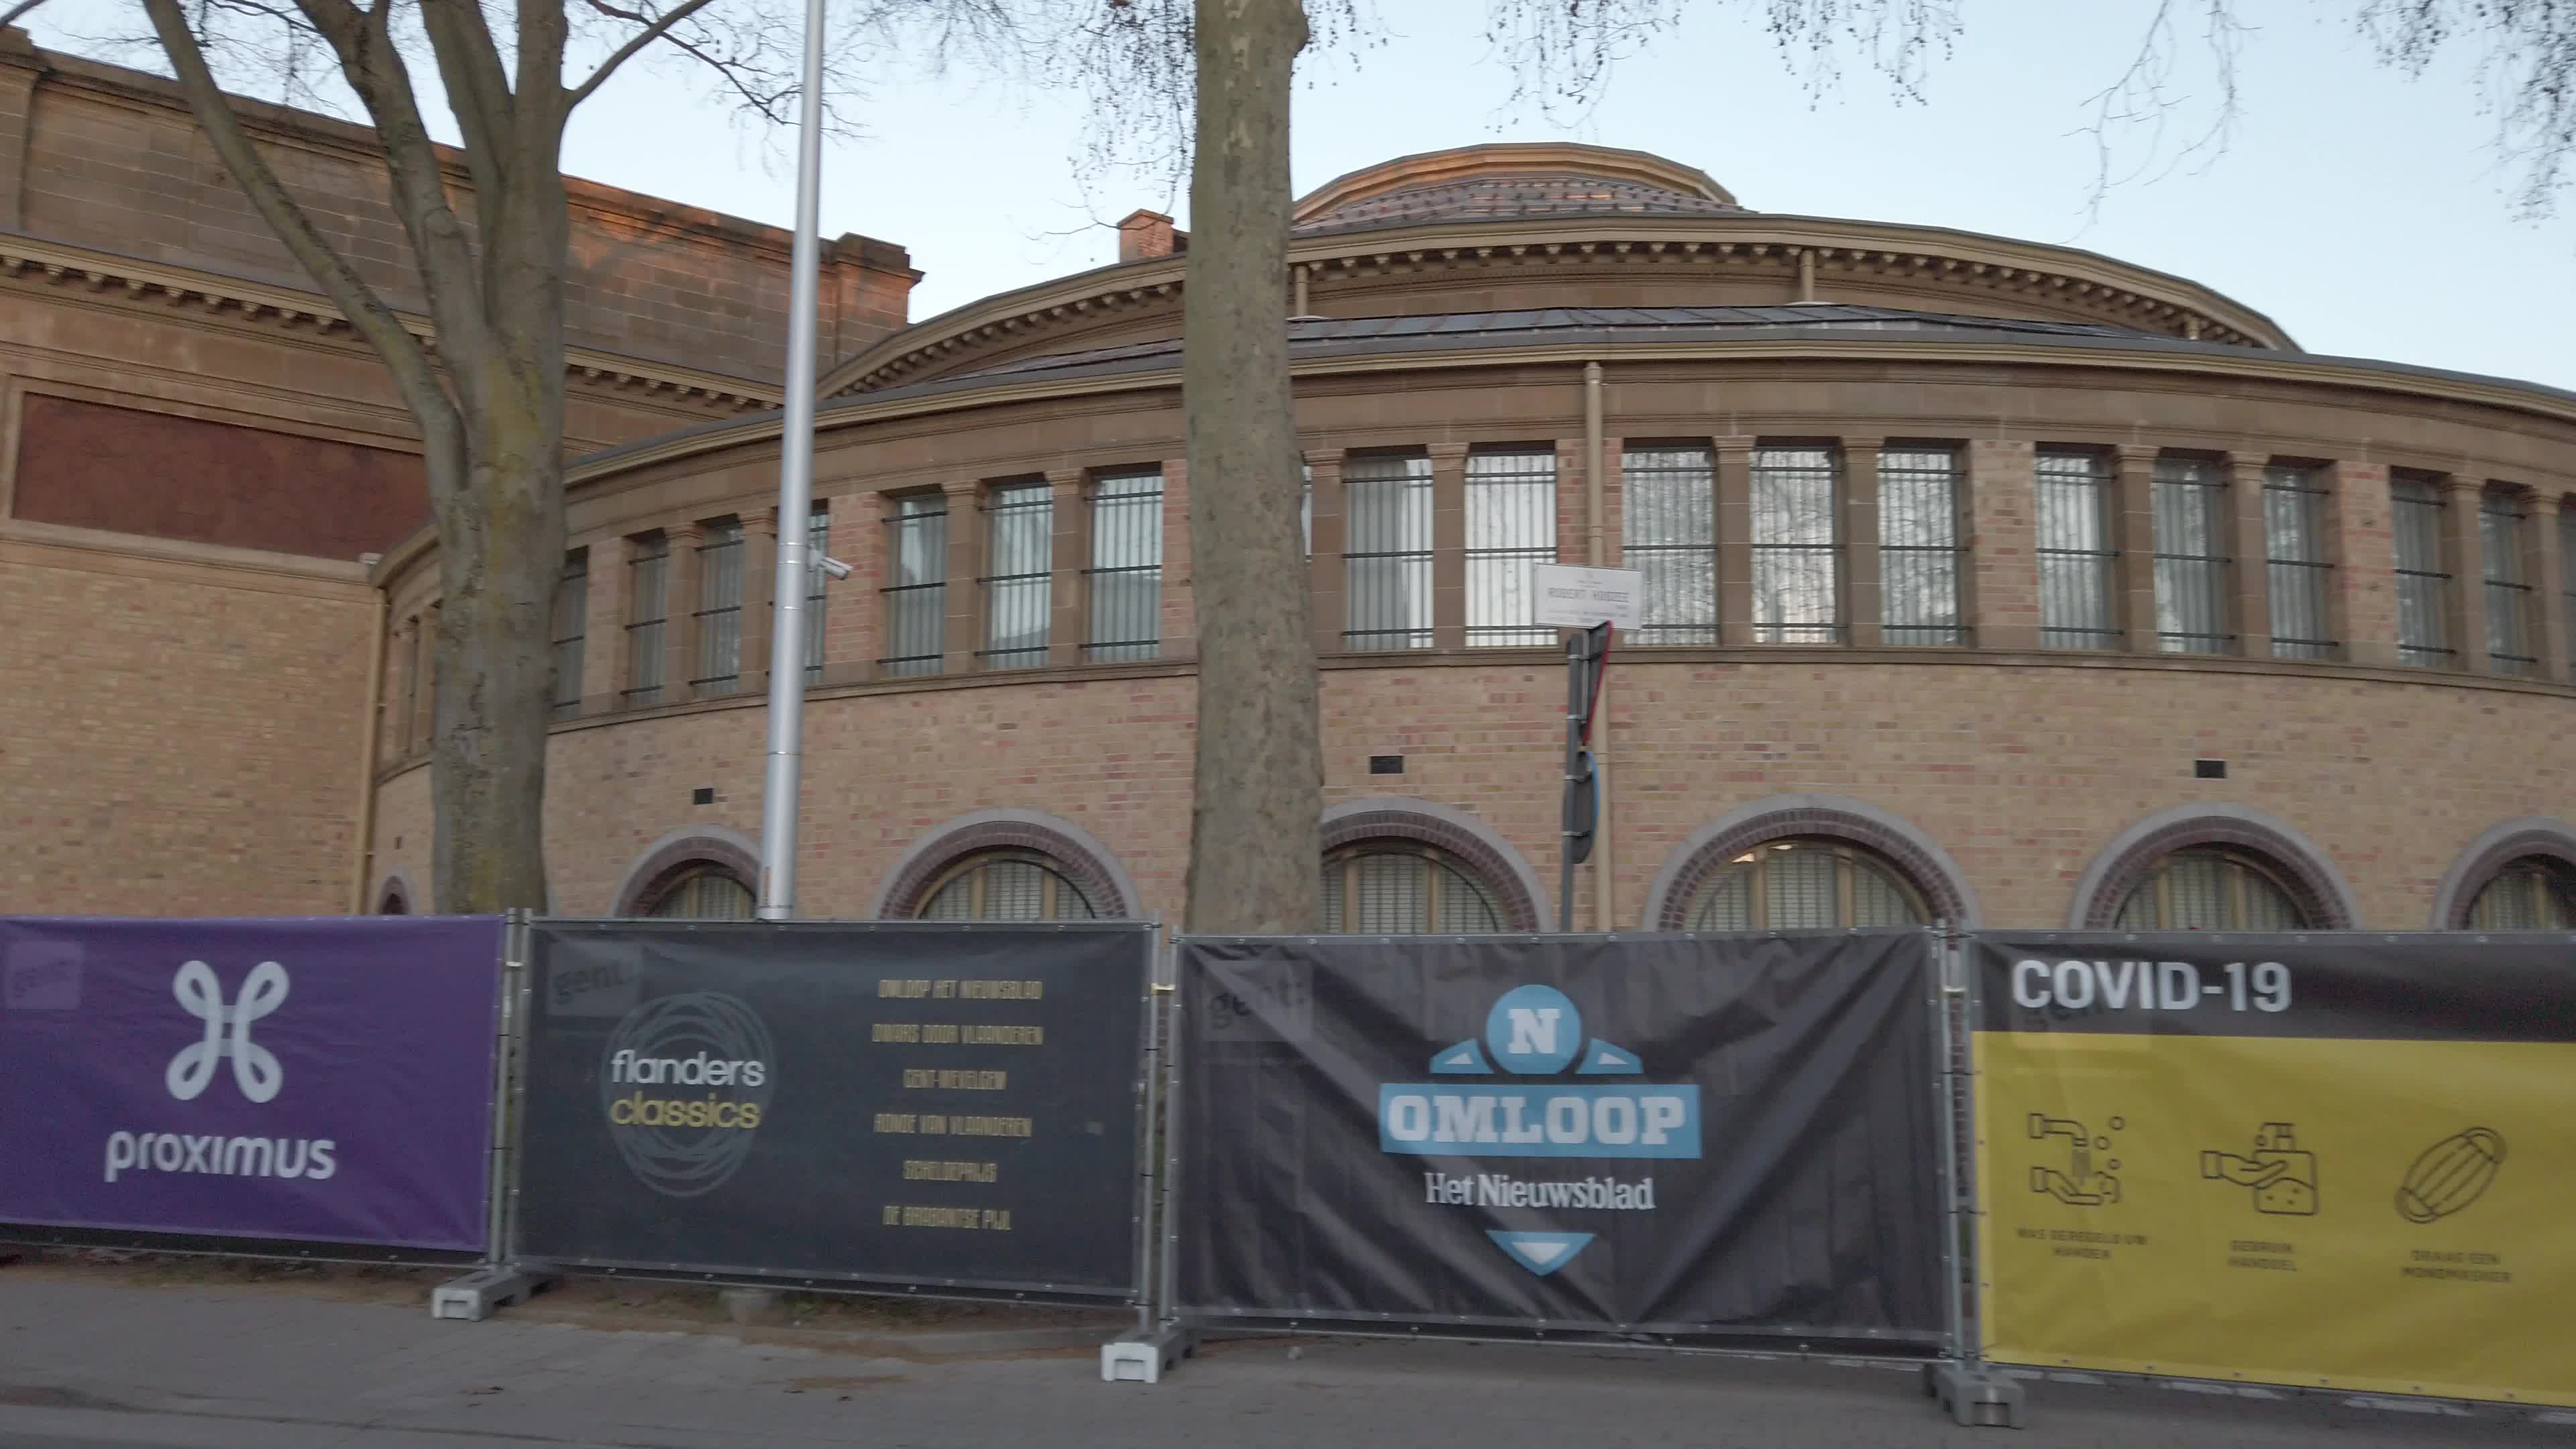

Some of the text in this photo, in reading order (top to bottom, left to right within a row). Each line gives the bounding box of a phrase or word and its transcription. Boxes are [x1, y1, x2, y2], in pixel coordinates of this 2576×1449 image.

[2013, 959, 2292, 1012] COVID-19
[1508, 1009, 1560, 1054] N
[611, 1049, 766, 1087] flanders
[610, 1090, 761, 1129] classics
[1387, 1095, 1686, 1145] OMLOOP
[104, 1131, 336, 1183] proximus
[1424, 1172, 1656, 1210] Het Nieuwsblad
